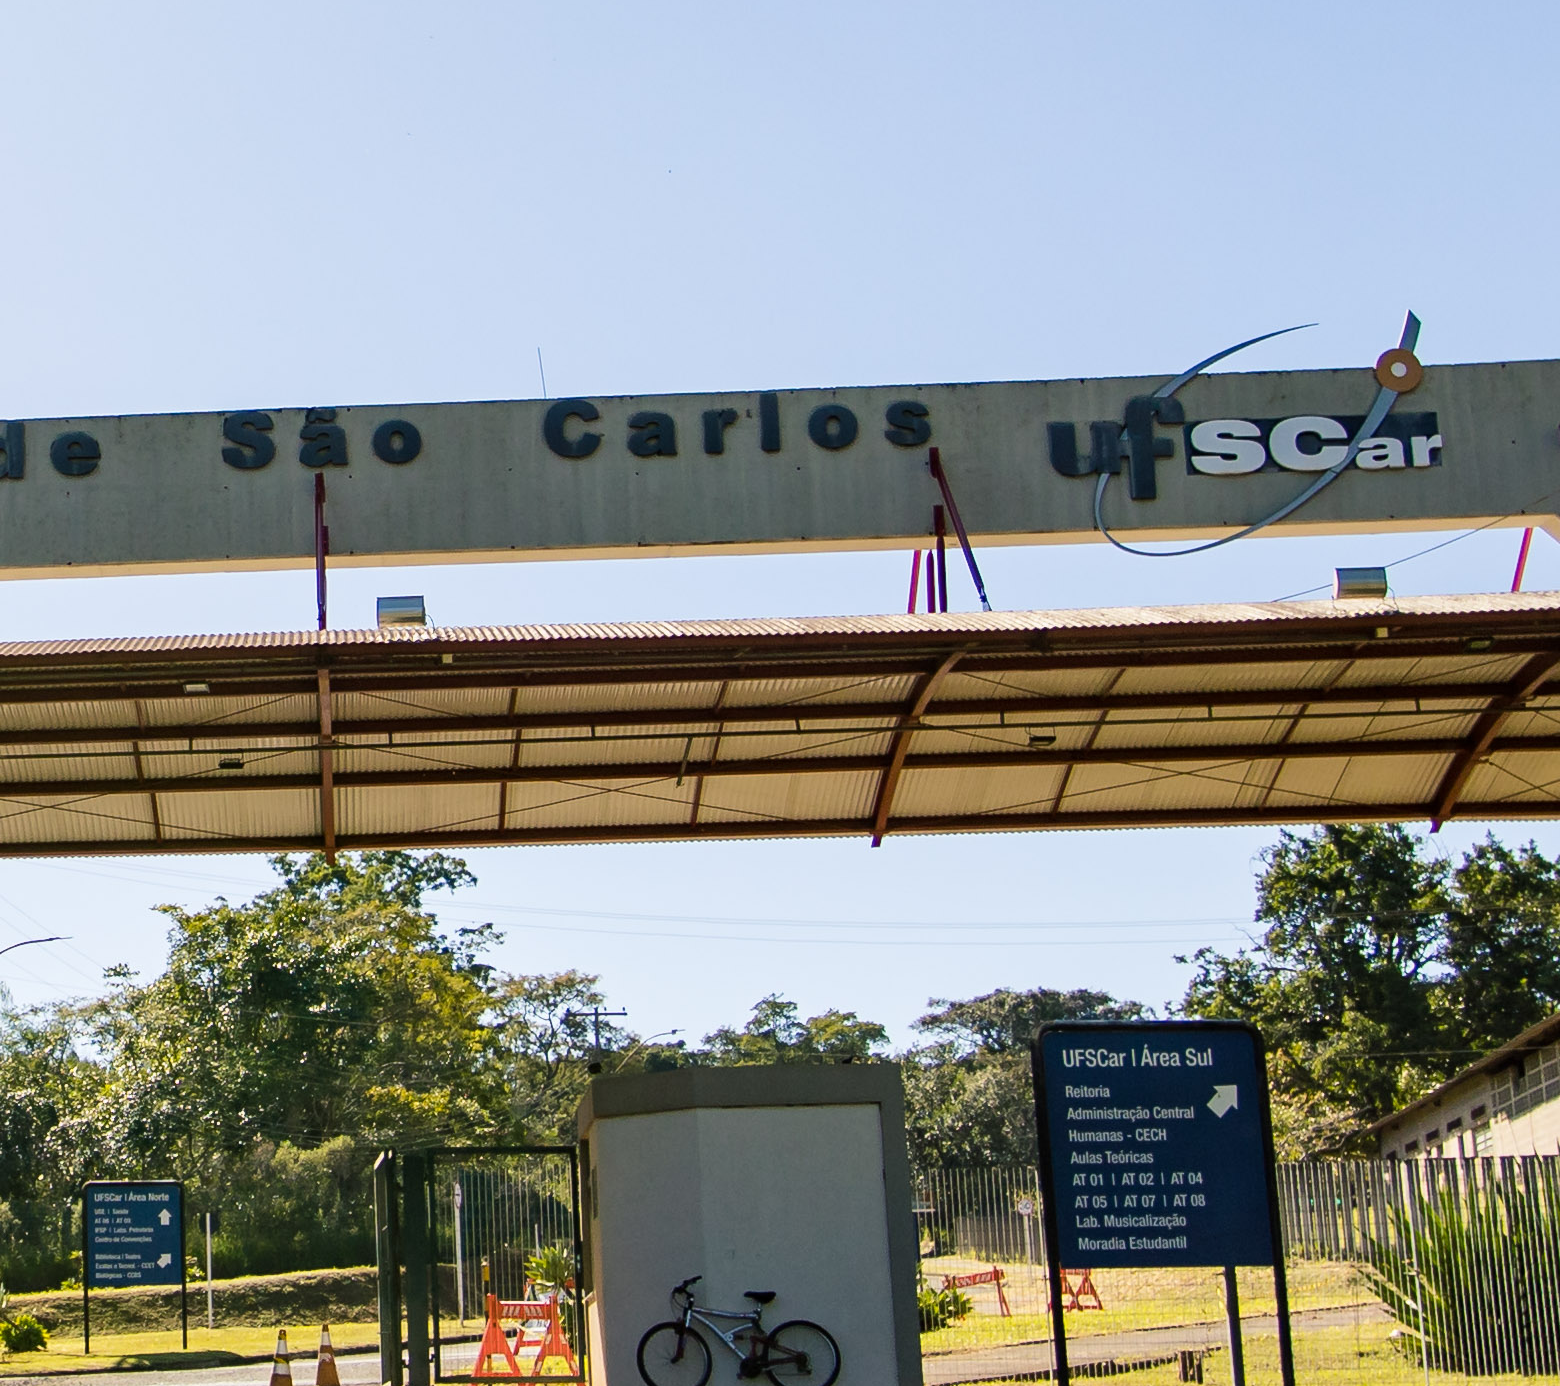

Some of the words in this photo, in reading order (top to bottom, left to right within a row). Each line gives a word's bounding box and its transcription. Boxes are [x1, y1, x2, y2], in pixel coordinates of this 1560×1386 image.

[221, 406, 422, 470] São
[543, 392, 932, 460] Carlos
[1062, 1048, 1126, 1068] UFSCar
[1140, 1043, 1182, 1067] Área
[1185, 1047, 1213, 1067] Sul
[1065, 1084, 1111, 1098] Reitoria
[1067, 1106, 1150, 1122] Administração
[1153, 1106, 1195, 1119] Central
[1068, 1129, 1124, 1142] Humanas
[1135, 1128, 1167, 1141] CECH
[1070, 1151, 1103, 1164] Aulas
[1105, 1150, 1154, 1164] Teóricas
[1073, 1174, 1087, 1186] AT
[1090, 1173, 1104, 1186] 01
[1122, 1173, 1136, 1186] AT
[1138, 1173, 1154, 1185] 02
[1171, 1172, 1185, 1185] AT
[1188, 1172, 1204, 1185] 04
[94, 1193, 122, 1202] UFSCar
[128, 1191, 147, 1202] Área
[148, 1193, 170, 1202] Norte
[1075, 1196, 1089, 1208] AT
[1092, 1195, 1107, 1208] 05
[1124, 1195, 1138, 1207] AT
[1141, 1195, 1156, 1207] 07
[1173, 1194, 1187, 1207] AT
[1190, 1194, 1206, 1207] 08
[1076, 1215, 1101, 1228] Lab.
[1104, 1213, 1187, 1229] Musicalização
[1078, 1237, 1126, 1250] Moradia
[1129, 1235, 1187, 1250] Estudantil
